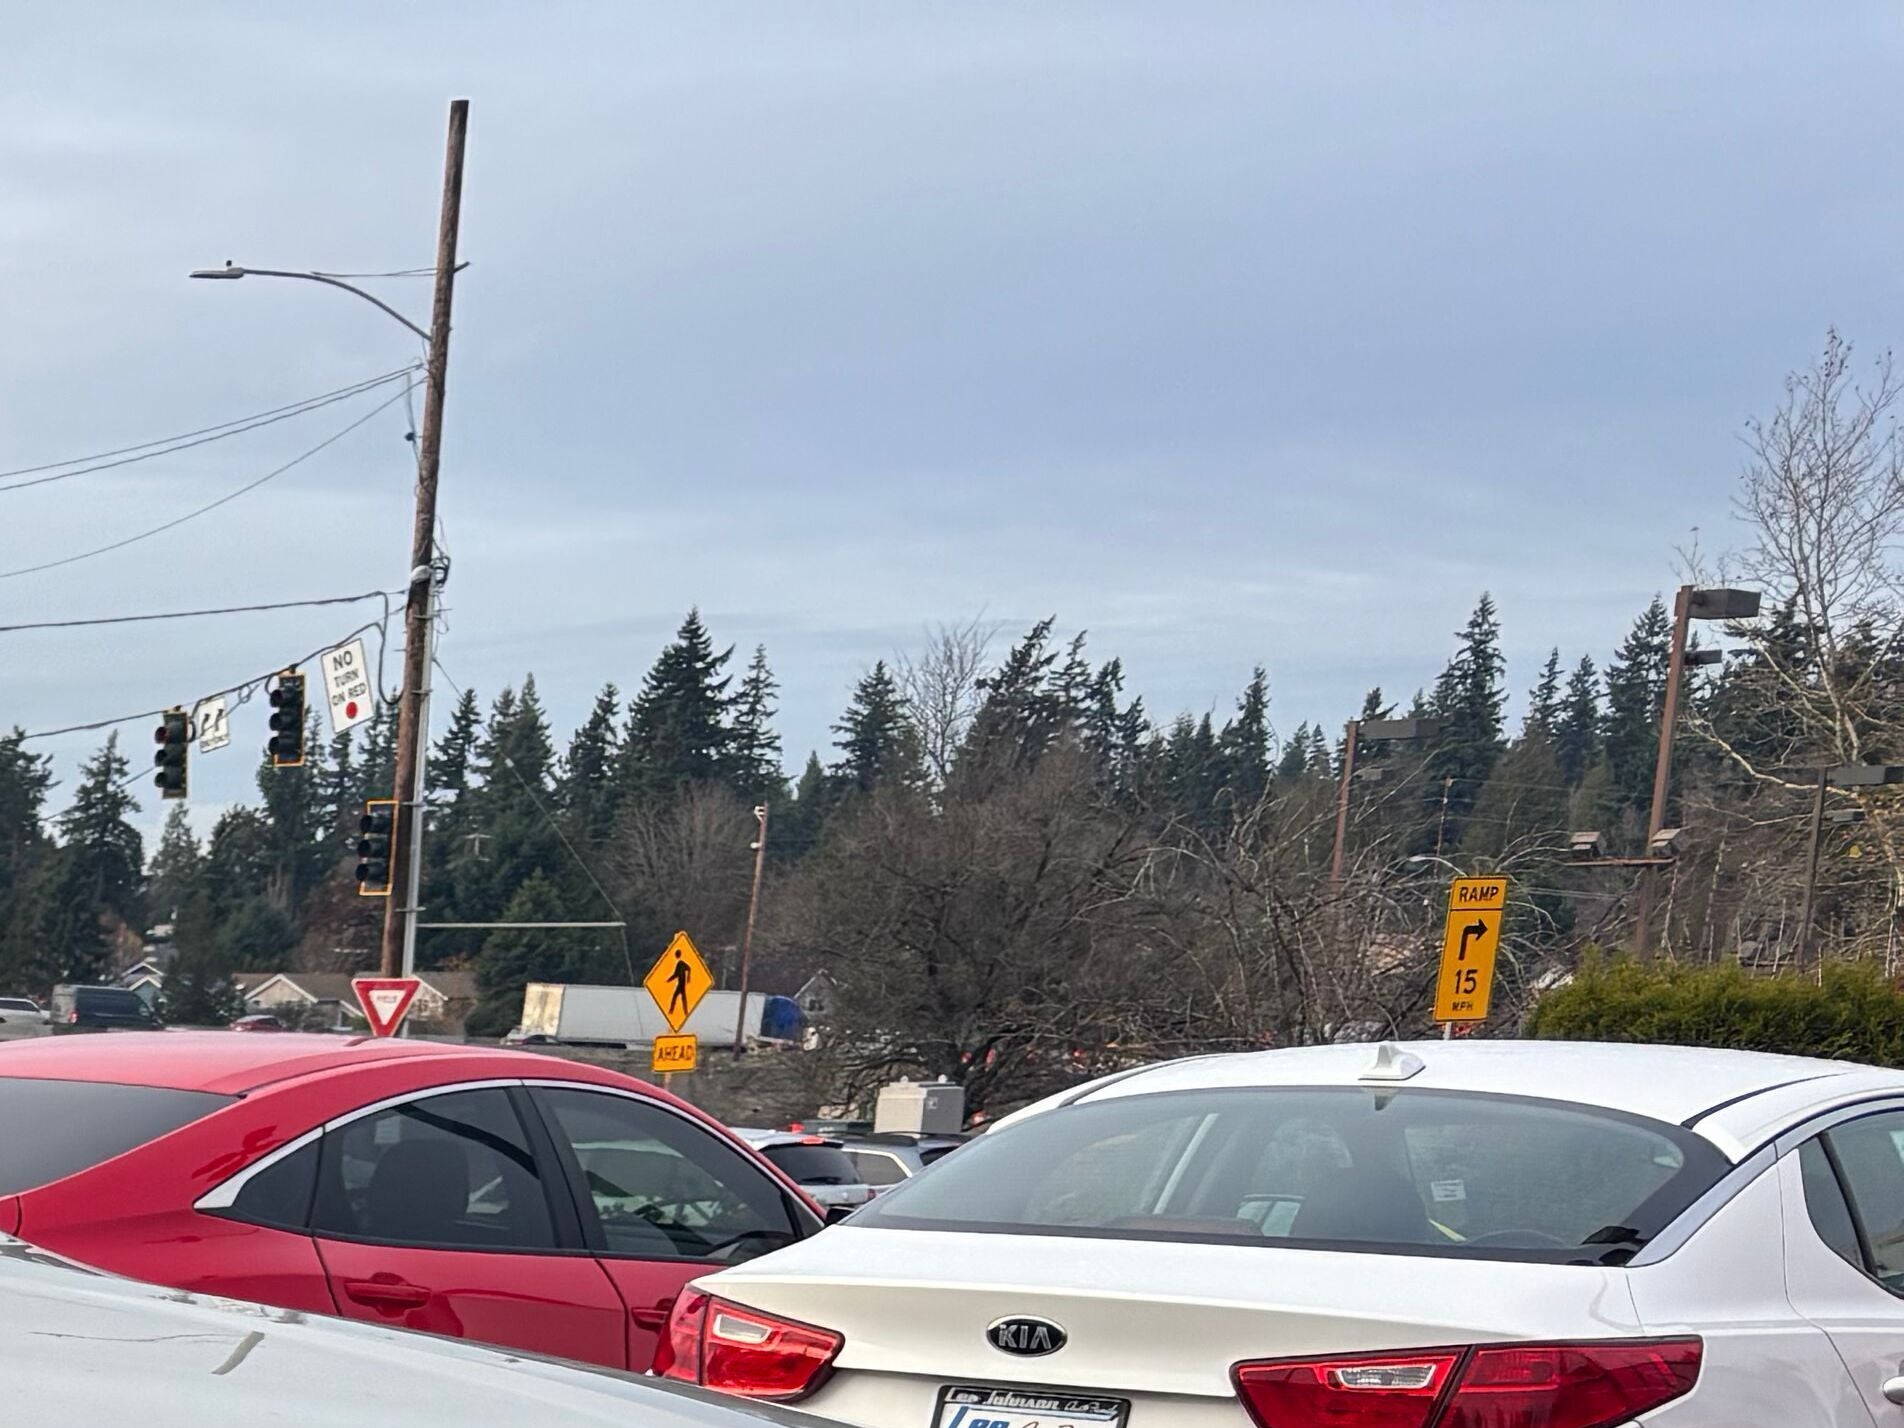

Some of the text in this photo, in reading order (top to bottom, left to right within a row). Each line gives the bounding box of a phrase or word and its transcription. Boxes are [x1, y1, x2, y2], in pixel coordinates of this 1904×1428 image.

[332, 650, 353, 671] NO
[334, 668, 359, 688] TURN
[332, 682, 367, 706] ON RED
[1458, 886, 1499, 902] RAMP
[1454, 969, 1478, 994] 15
[1452, 1002, 1473, 1011] MPH
[656, 1045, 694, 1062] AHEAD
[998, 1324, 1052, 1349] KIA
[944, 1387, 980, 1404] Lee
[983, 1390, 1059, 1411] Johnson
